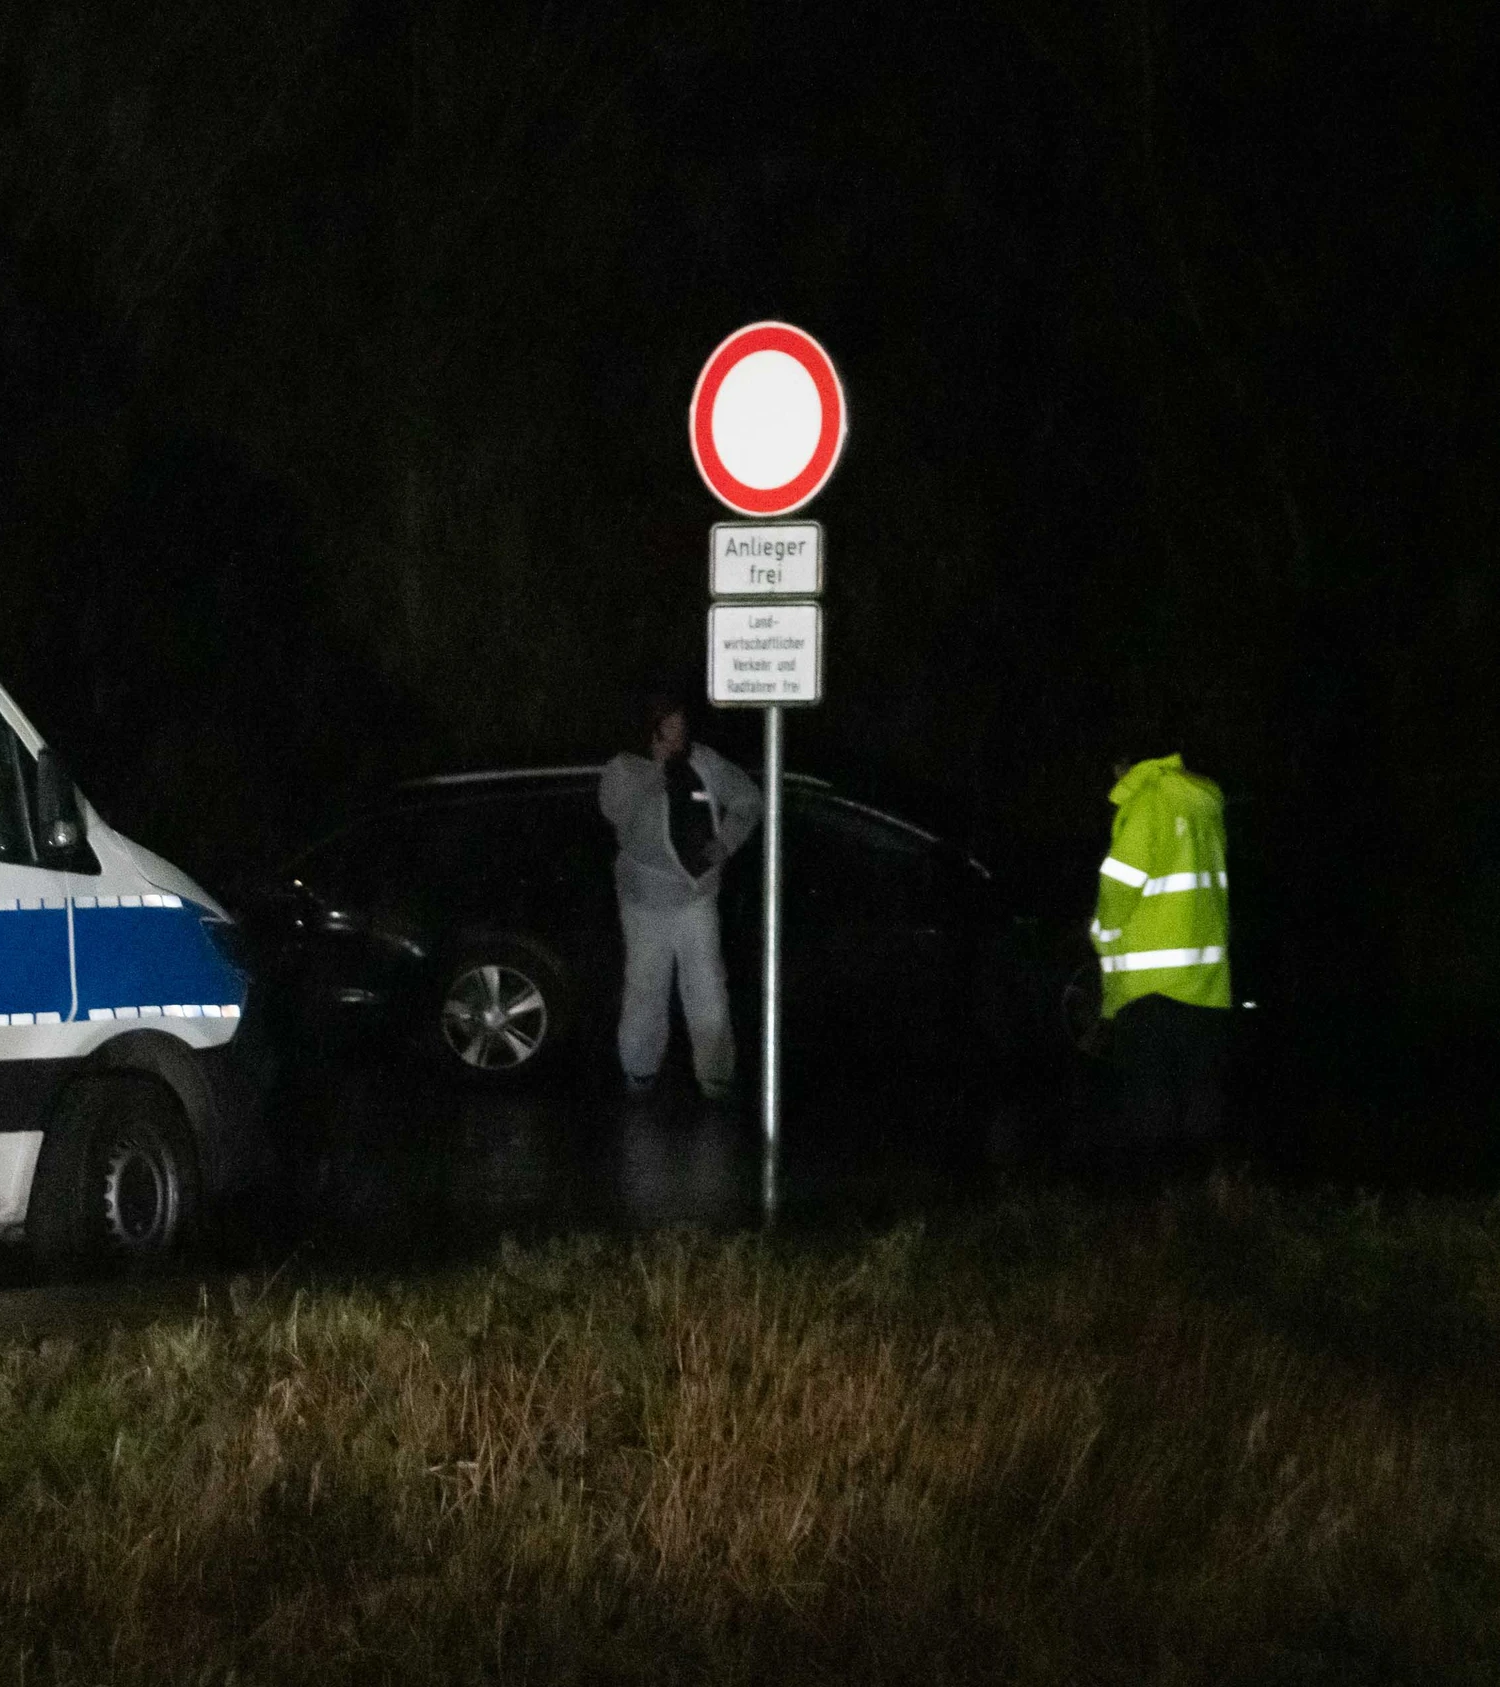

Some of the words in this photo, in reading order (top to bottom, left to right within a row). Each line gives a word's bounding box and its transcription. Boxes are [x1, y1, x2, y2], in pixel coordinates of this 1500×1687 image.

[725, 537, 806, 561] Anlieger
[750, 564, 782, 584] frei
[749, 615, 780, 629] Land-
[777, 657, 796, 671] und
